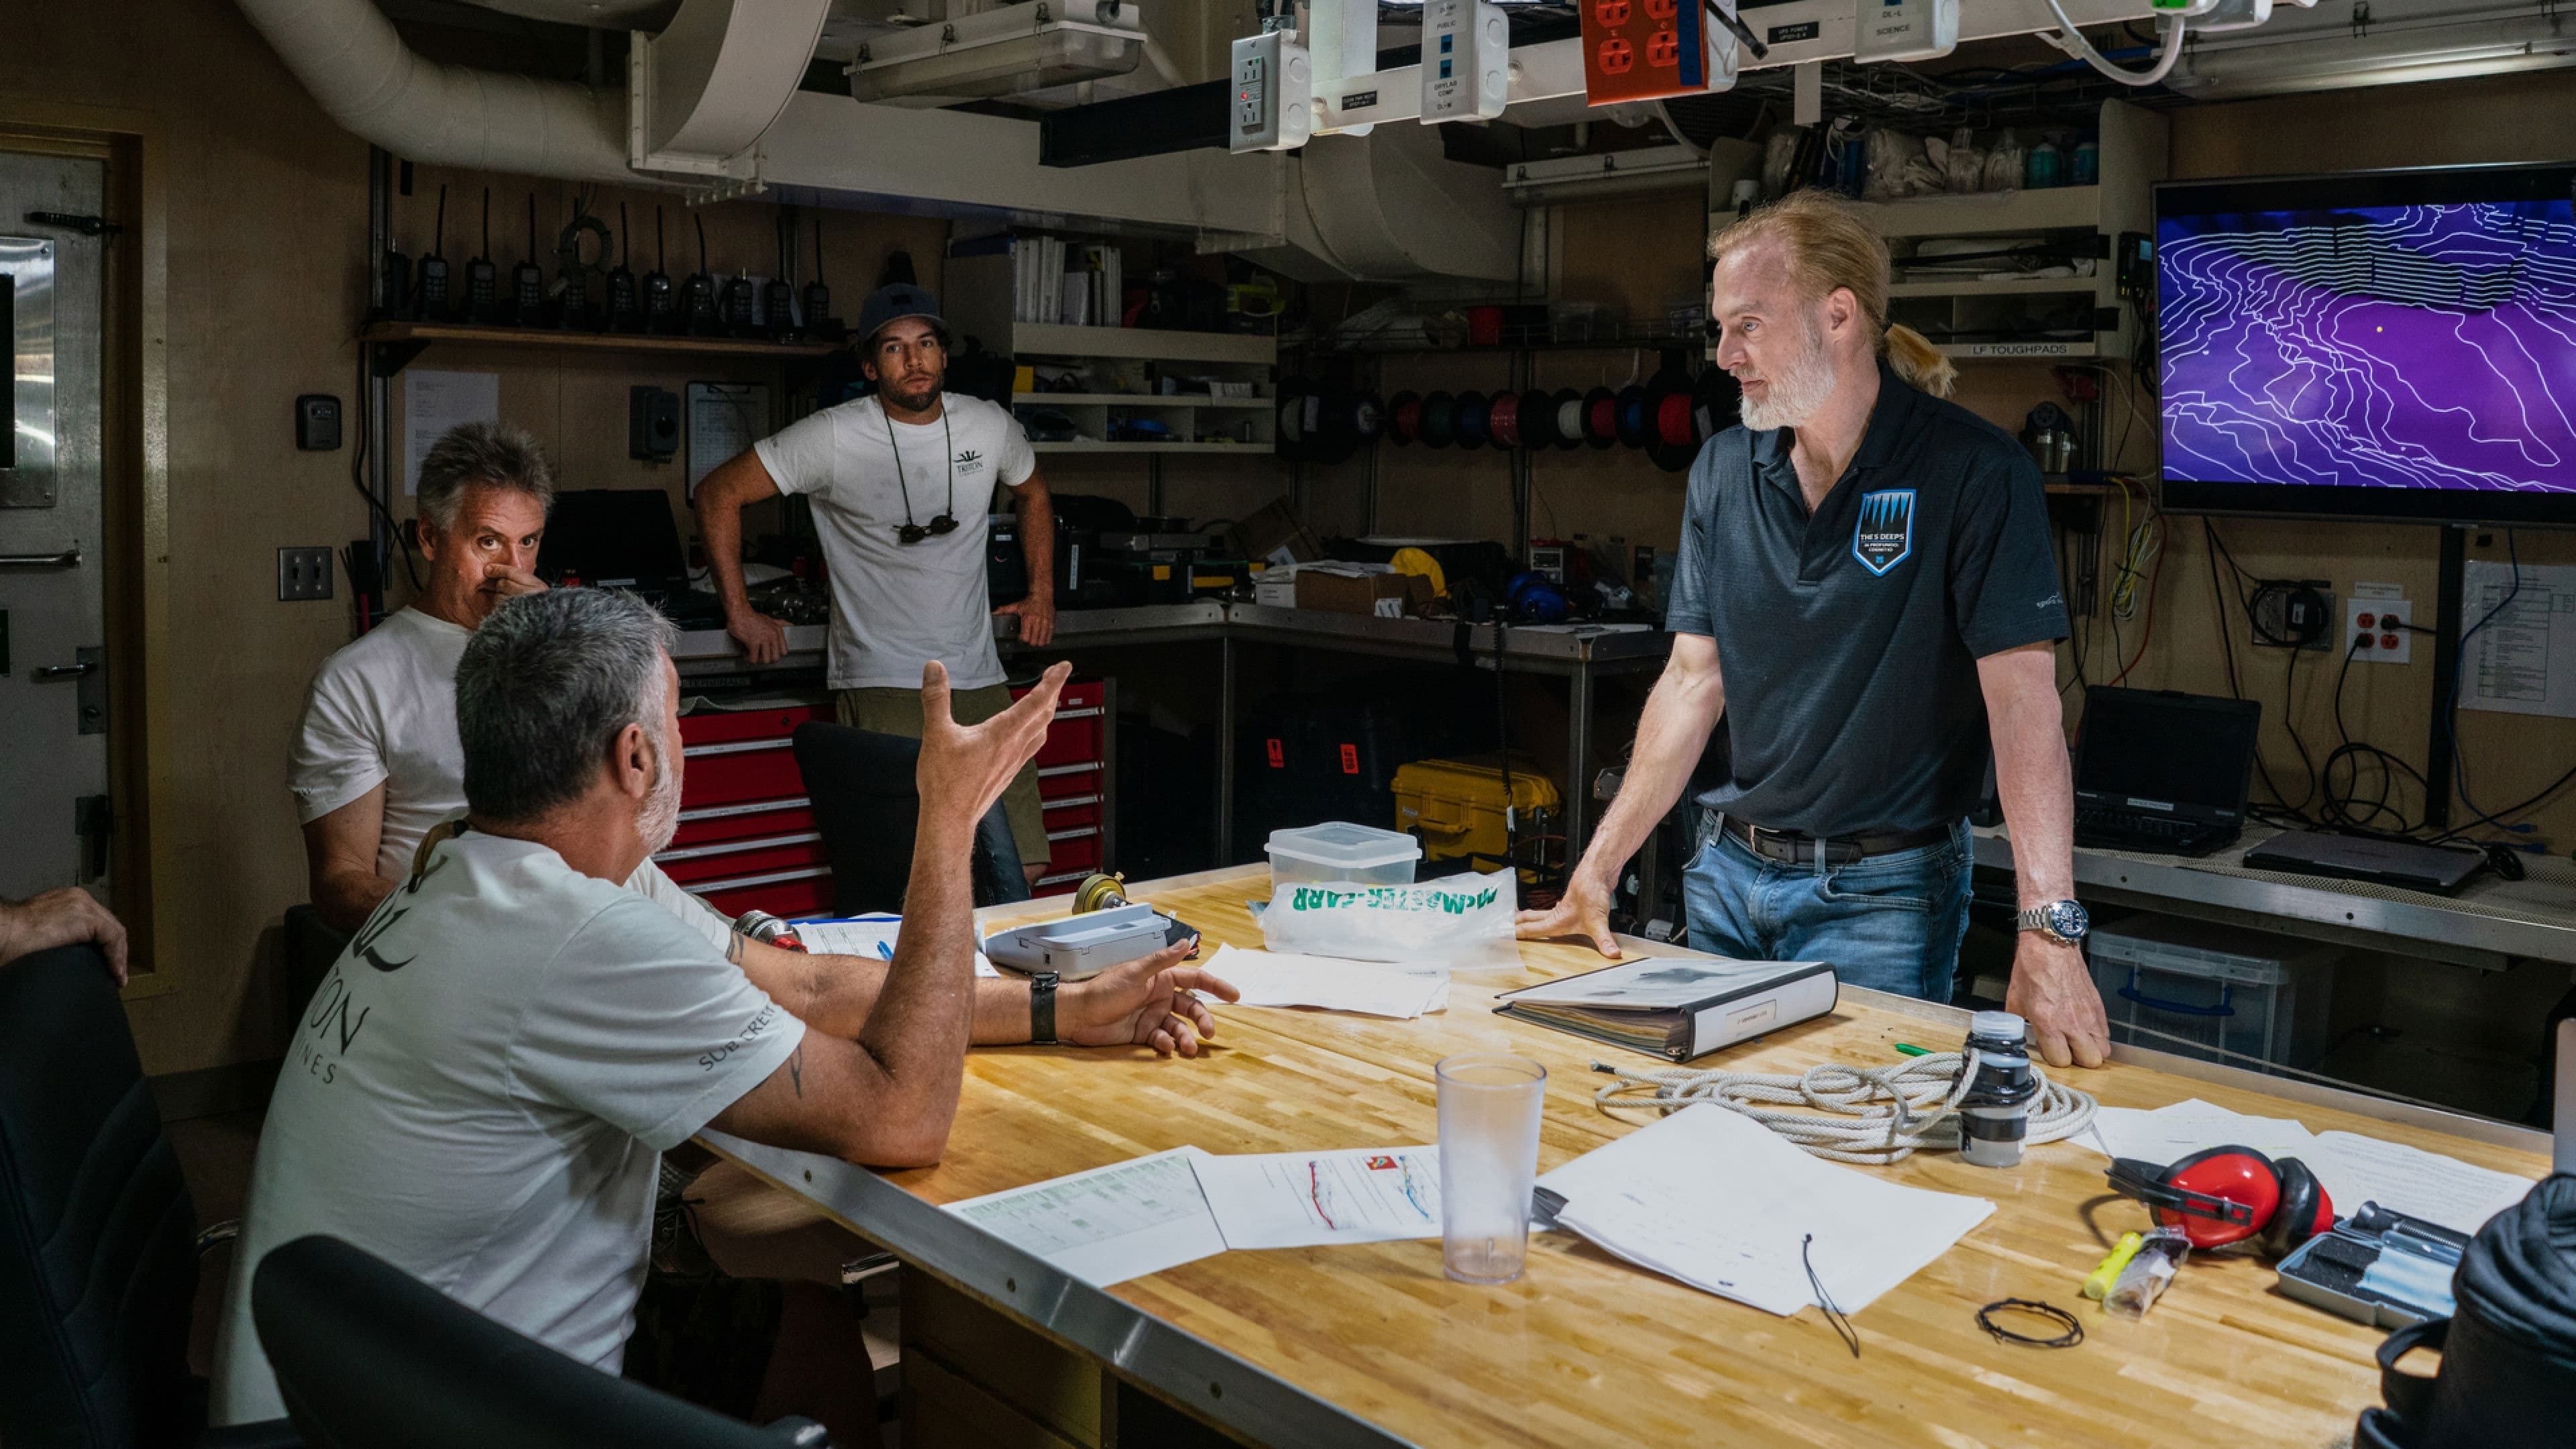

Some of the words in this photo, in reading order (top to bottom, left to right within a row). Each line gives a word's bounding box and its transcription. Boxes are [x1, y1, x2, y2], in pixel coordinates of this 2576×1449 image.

[1973, 345, 1987, 355] LF
[1990, 344, 2068, 355] TOUGHPADS
[698, 1040, 740, 1072] SUB
